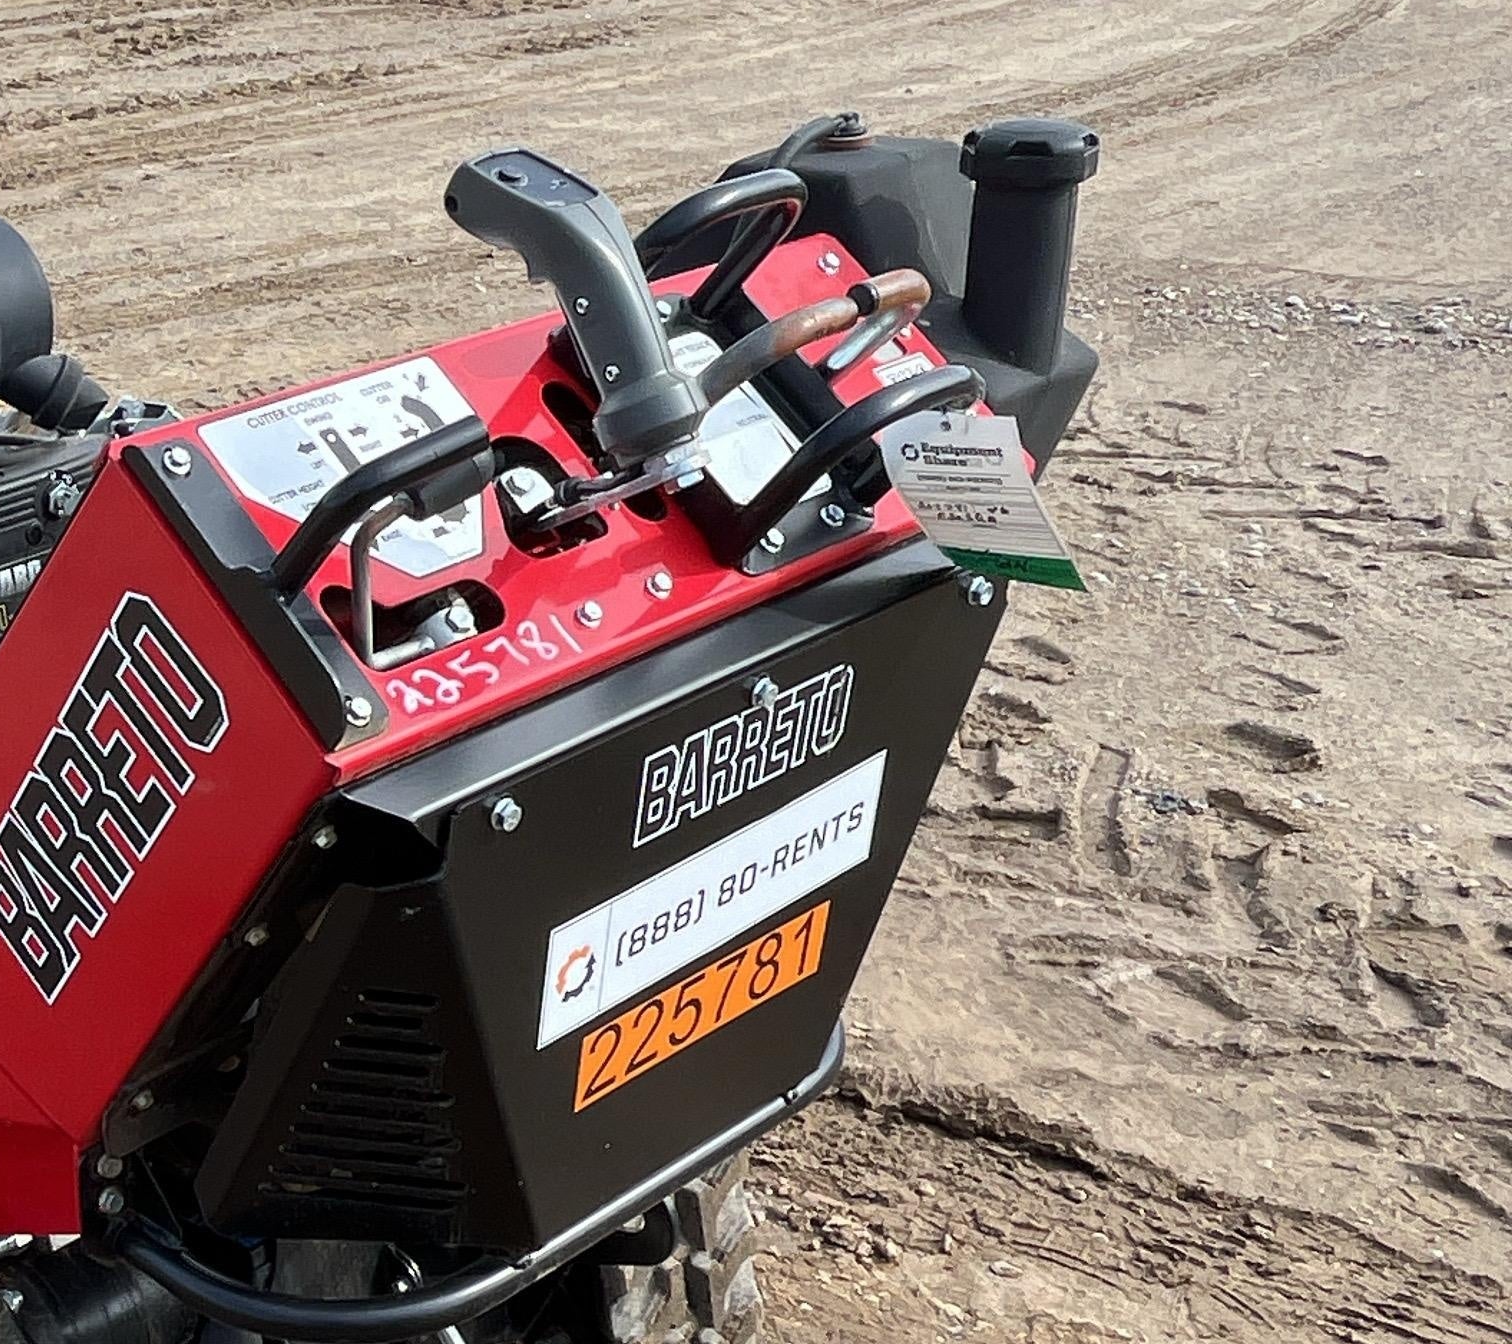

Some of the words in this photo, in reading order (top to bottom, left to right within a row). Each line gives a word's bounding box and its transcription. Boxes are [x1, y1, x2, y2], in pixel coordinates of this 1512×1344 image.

[246, 408, 288, 429] CUTTER
[287, 391, 344, 417] CONTROL
[920, 441, 1004, 459] Equipment
[386, 613, 584, 715] 225781
[632, 663, 855, 849] BARRETO
[717, 800, 866, 909] 80-RENTS
[580, 910, 817, 1104] 225781
